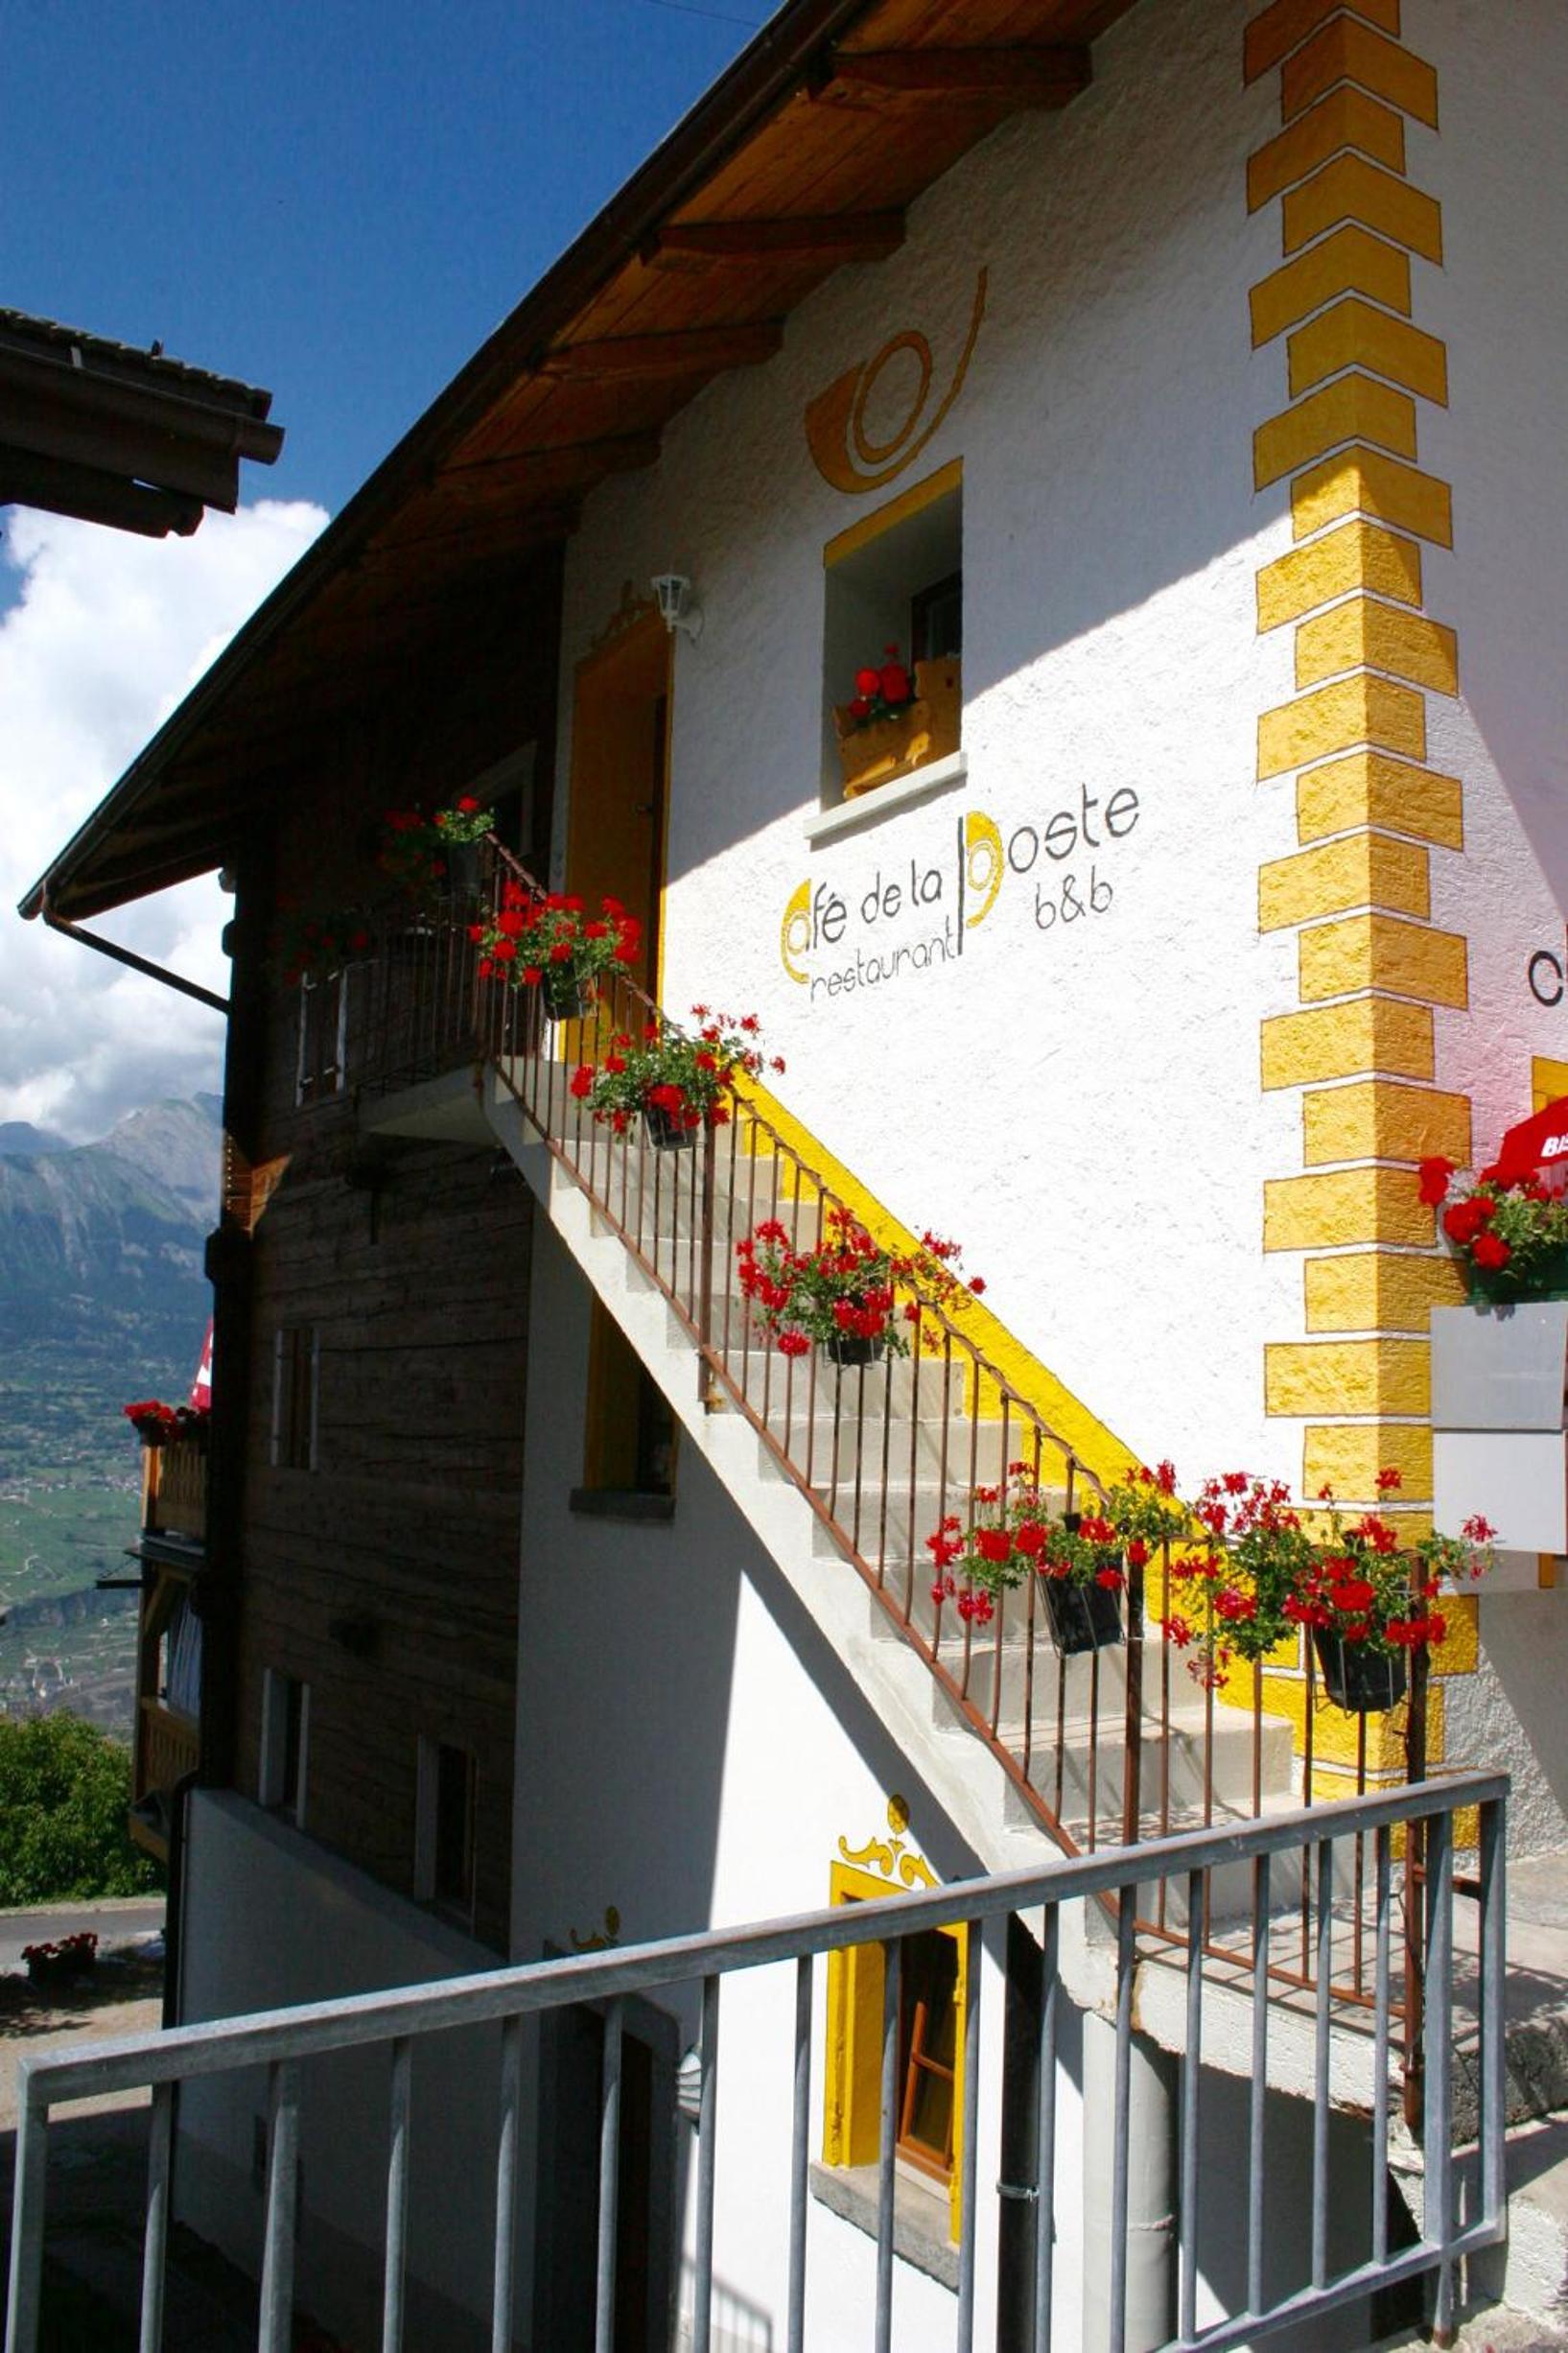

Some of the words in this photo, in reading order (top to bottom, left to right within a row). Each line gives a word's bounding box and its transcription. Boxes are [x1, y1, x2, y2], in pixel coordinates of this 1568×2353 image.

[860, 870, 901, 925] de
[911, 859, 943, 906] la
[1035, 865, 1113, 929] b&b
[810, 914, 956, 1002] restaurant
